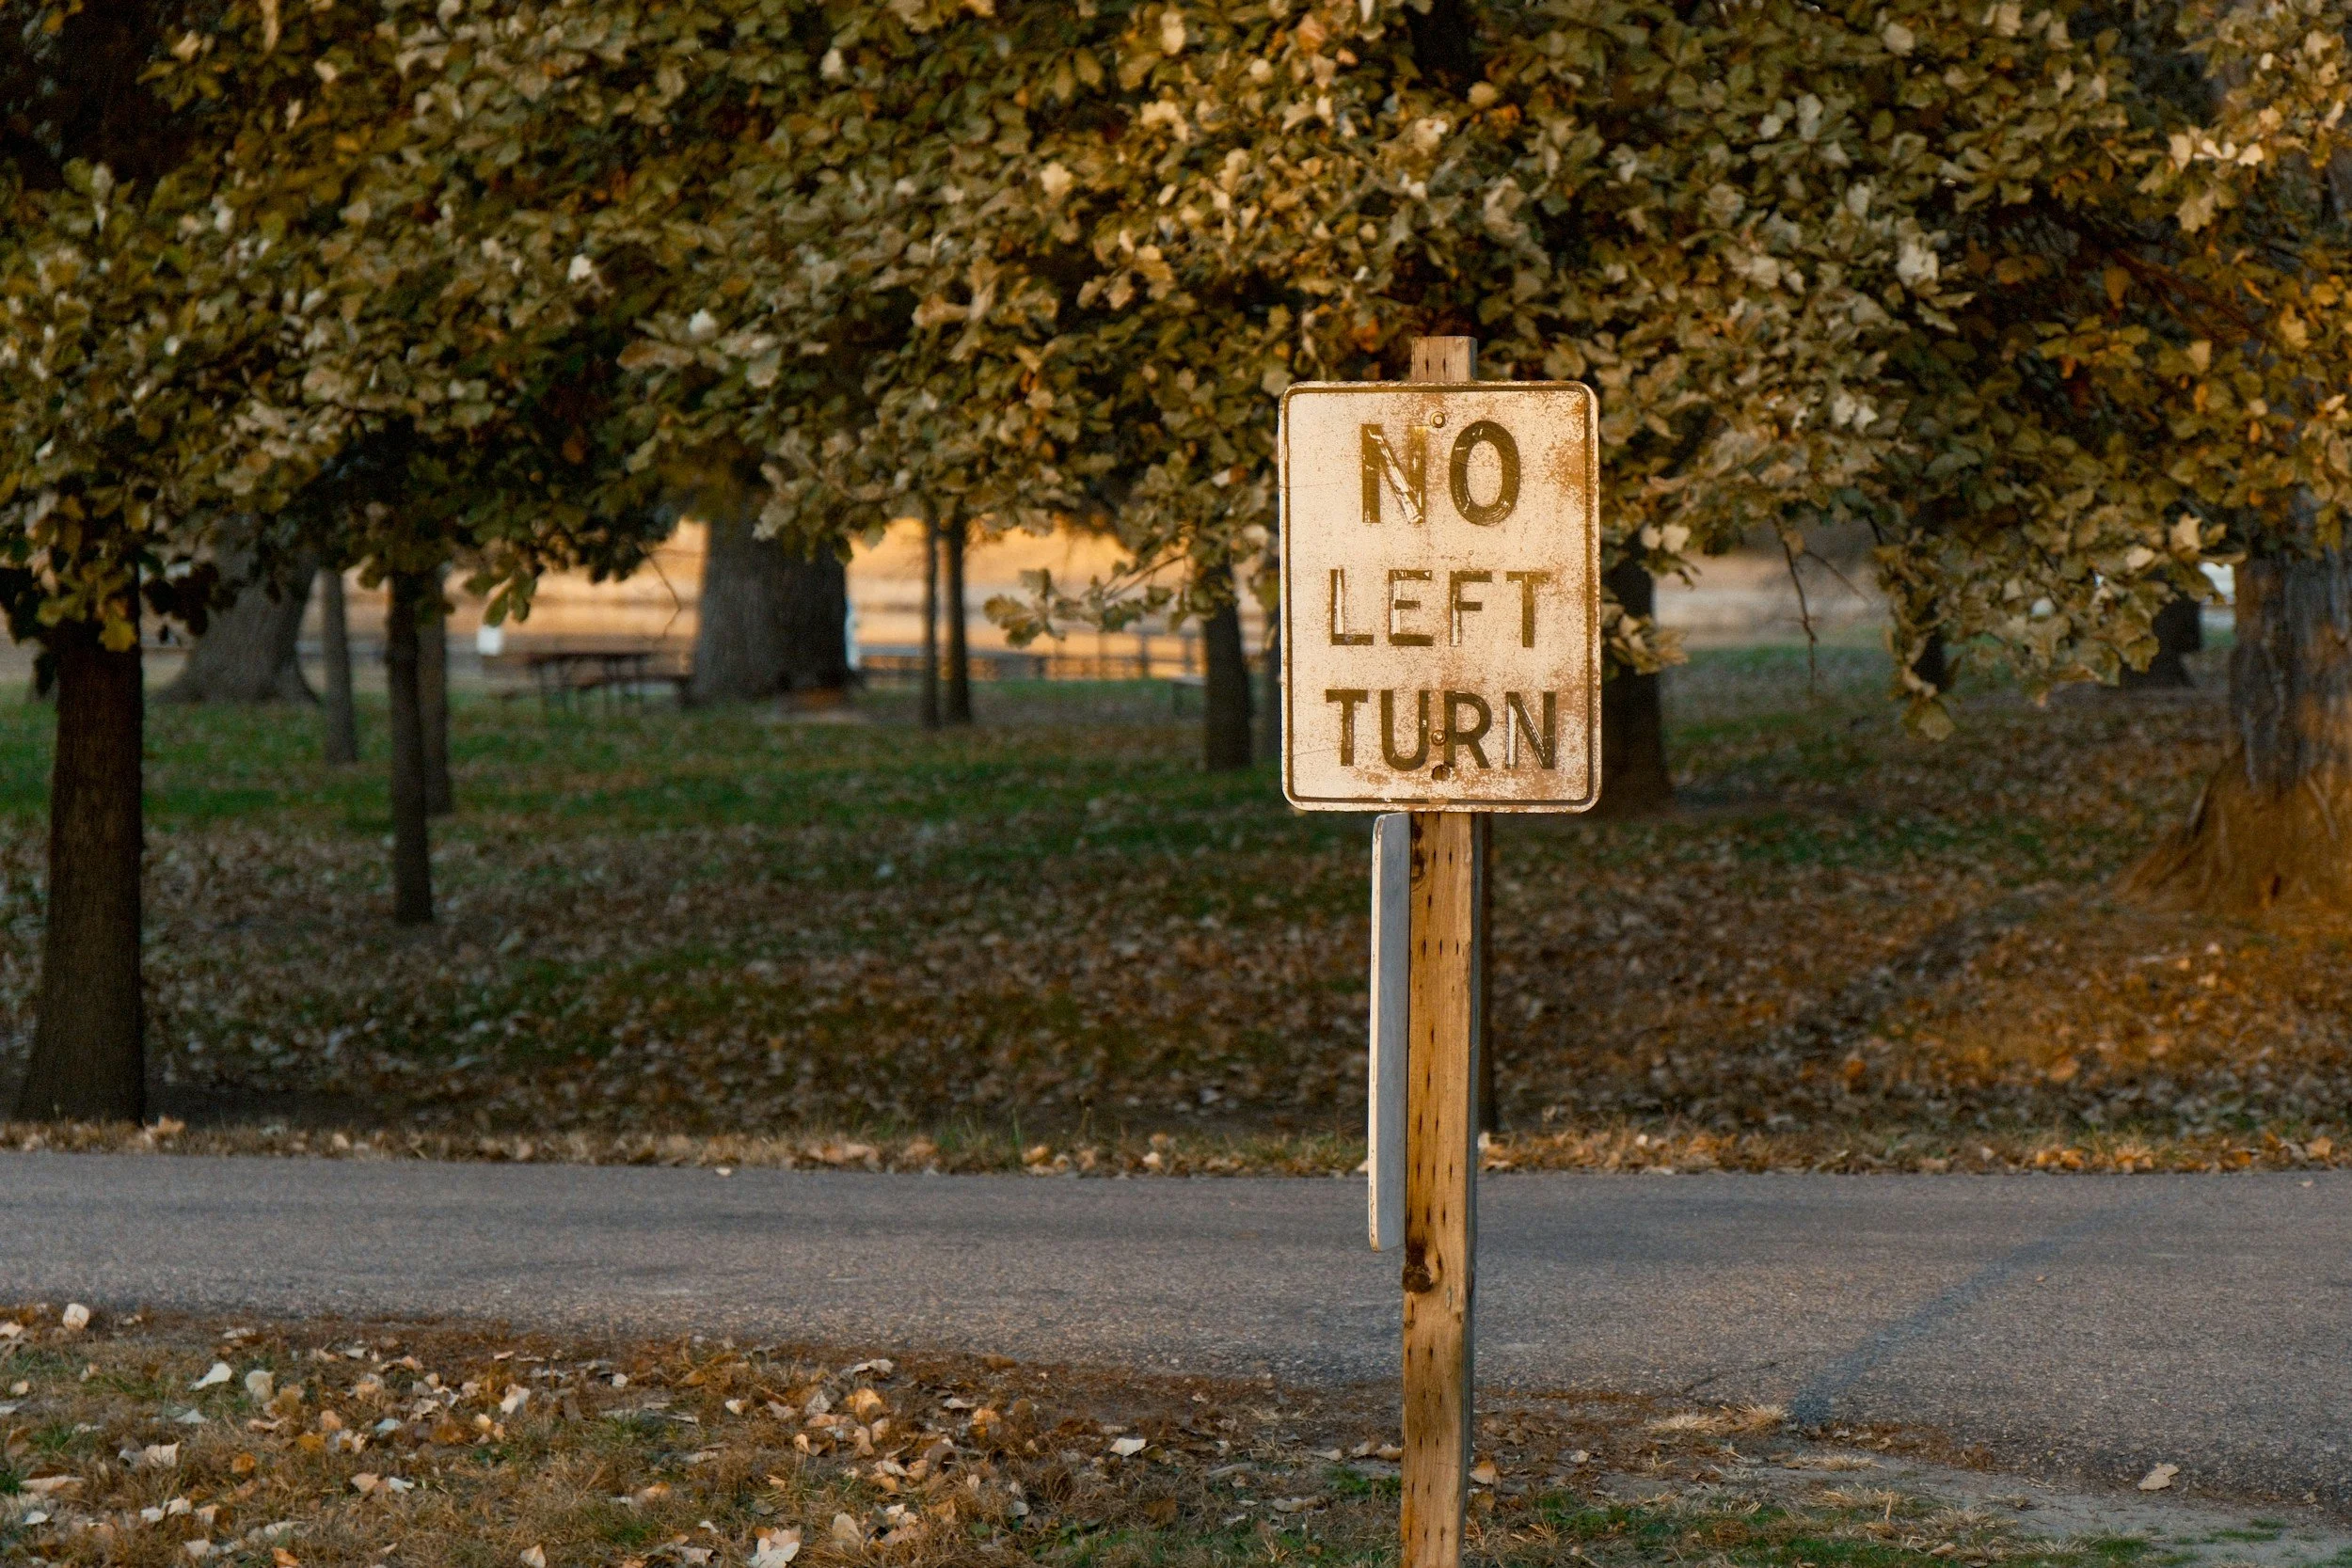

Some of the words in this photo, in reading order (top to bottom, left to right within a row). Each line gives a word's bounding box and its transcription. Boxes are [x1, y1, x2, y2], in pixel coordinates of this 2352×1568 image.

[1360, 420, 1521, 527] NO
[1329, 568, 1550, 648] LEFT
[1325, 689, 1557, 772] TURN
